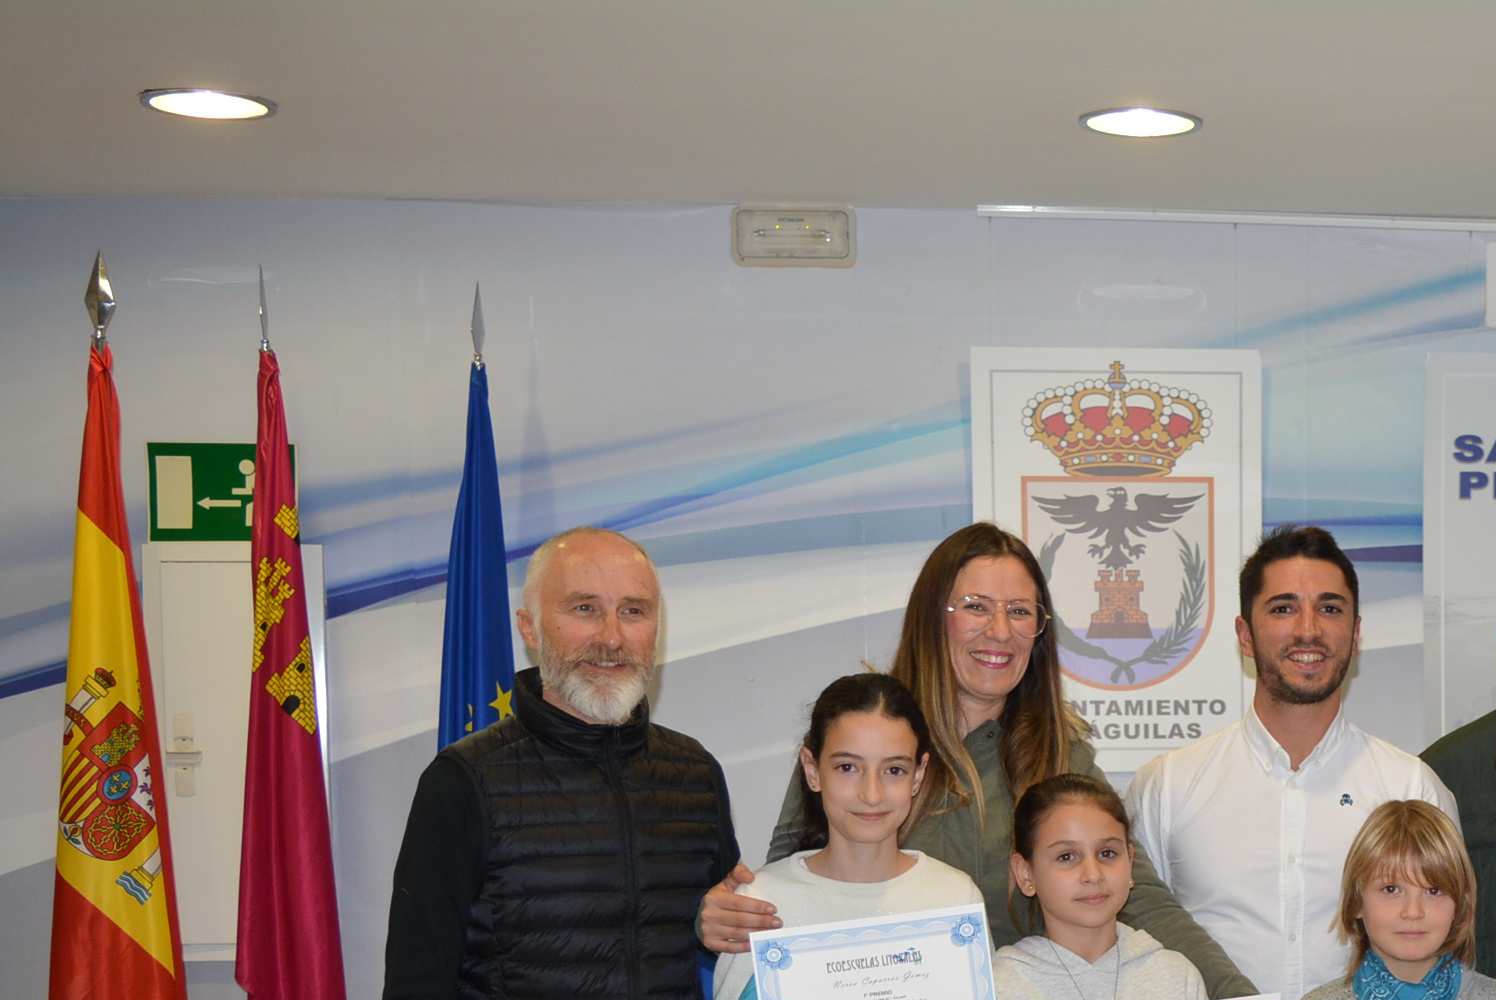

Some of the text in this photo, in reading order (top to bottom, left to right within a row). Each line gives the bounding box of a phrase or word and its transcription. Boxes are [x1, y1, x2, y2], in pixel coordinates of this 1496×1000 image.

[1072, 699, 1227, 716] NTAMIENTO
[826, 956, 880, 974] ECOESCUELAS
[869, 989, 893, 997] PREMIO
